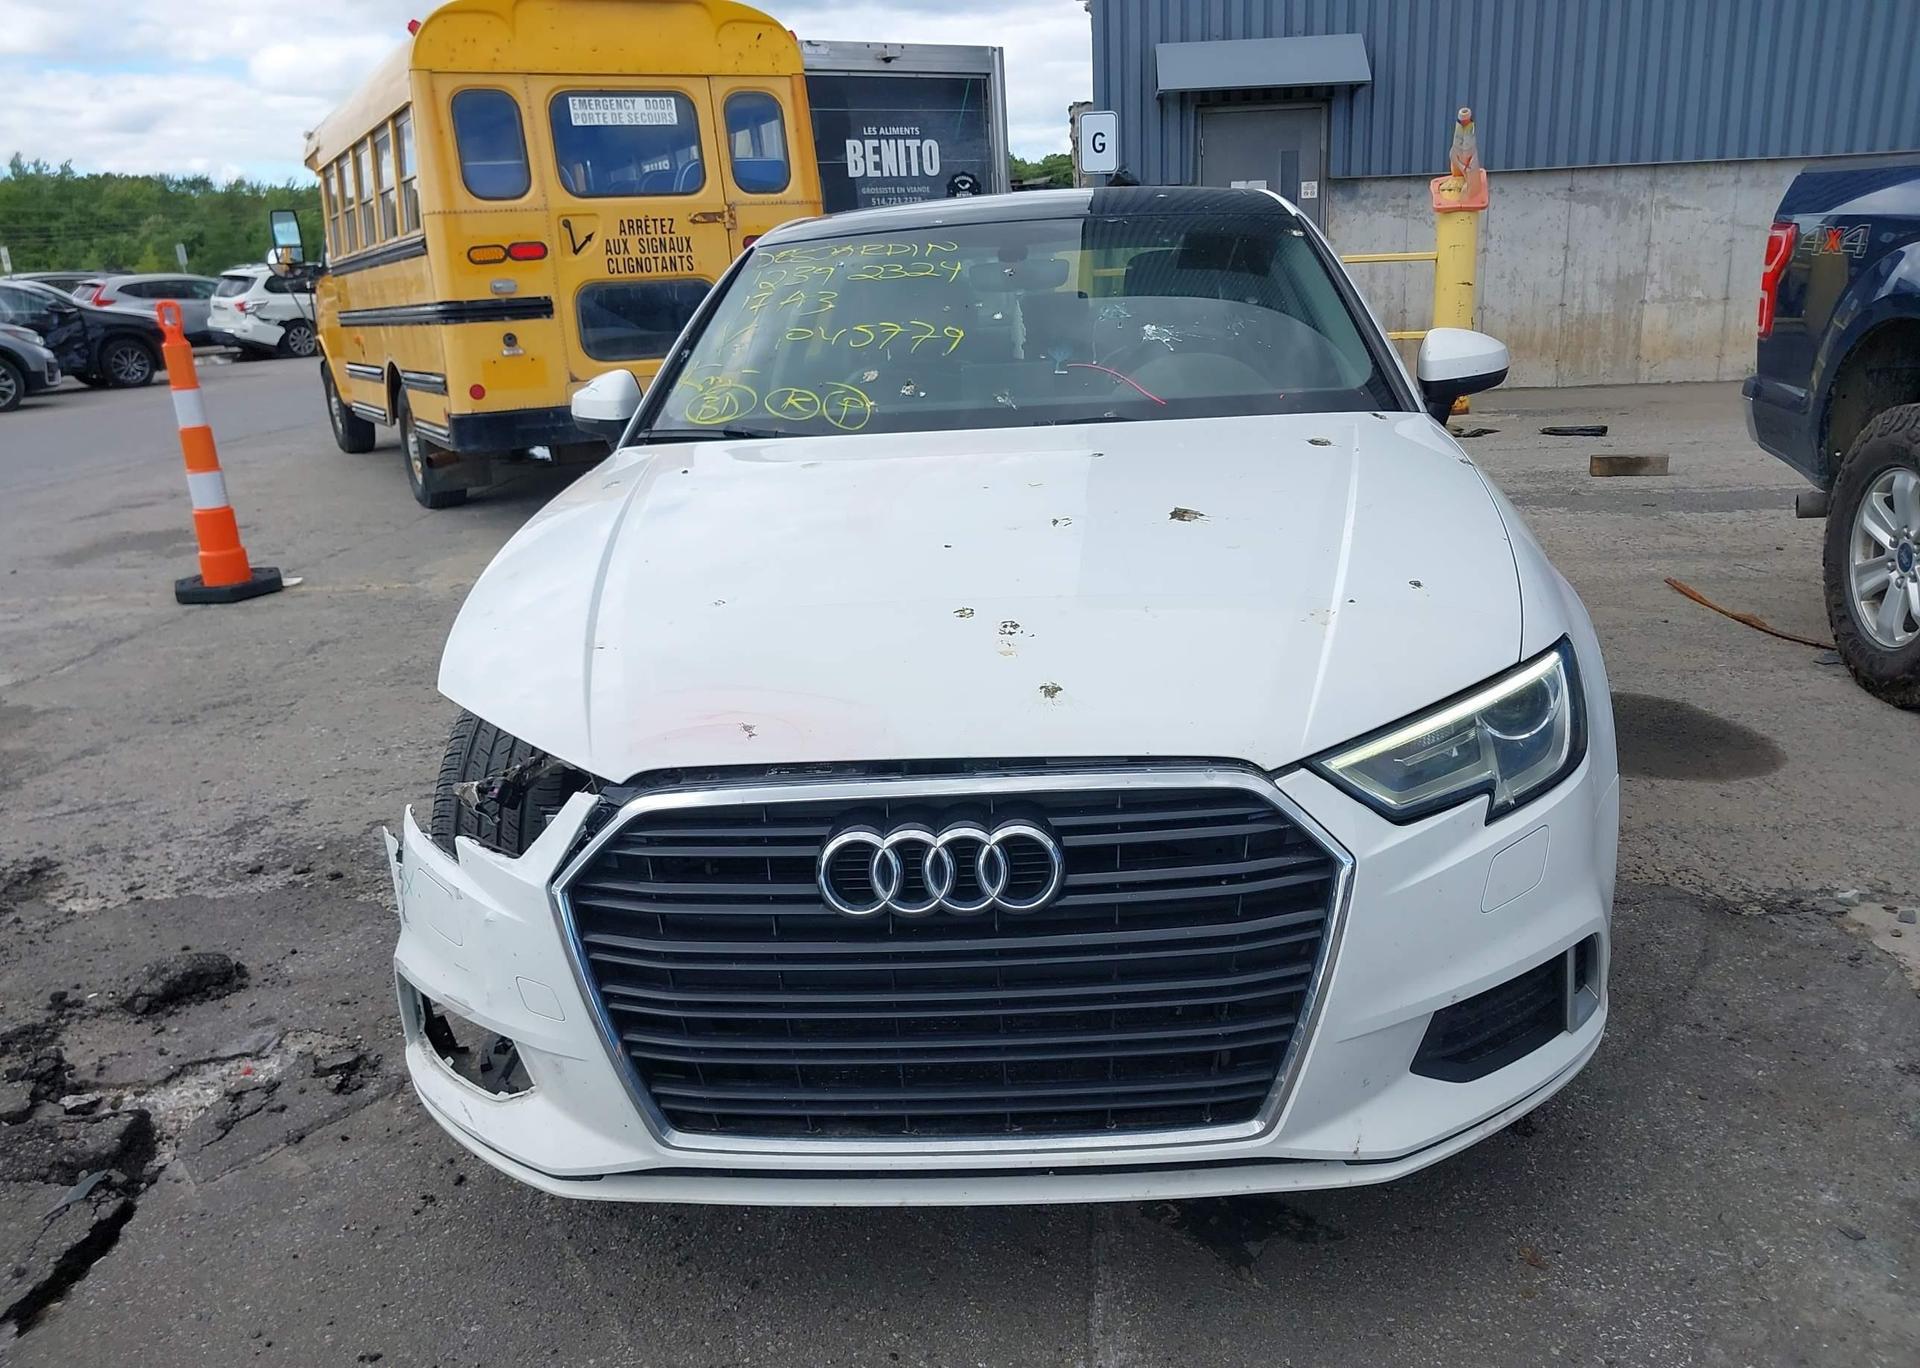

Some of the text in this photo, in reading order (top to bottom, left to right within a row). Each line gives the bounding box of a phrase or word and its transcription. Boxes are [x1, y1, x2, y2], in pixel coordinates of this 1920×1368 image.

[572, 98, 673, 111] EMERGENCY DOOR
[574, 112, 675, 124] PORTE DE SECOURS
[863, 127, 920, 136] LES ALIMENTS
[1092, 132, 1106, 153] G
[845, 139, 941, 178] BENITO
[861, 185, 930, 195] GROSSISTE EN VIANDE
[619, 216, 675, 235] ARRÊTEZ
[605, 237, 693, 256] AUX SIGNAUX
[607, 256, 694, 274] CLIGNOTANTS
